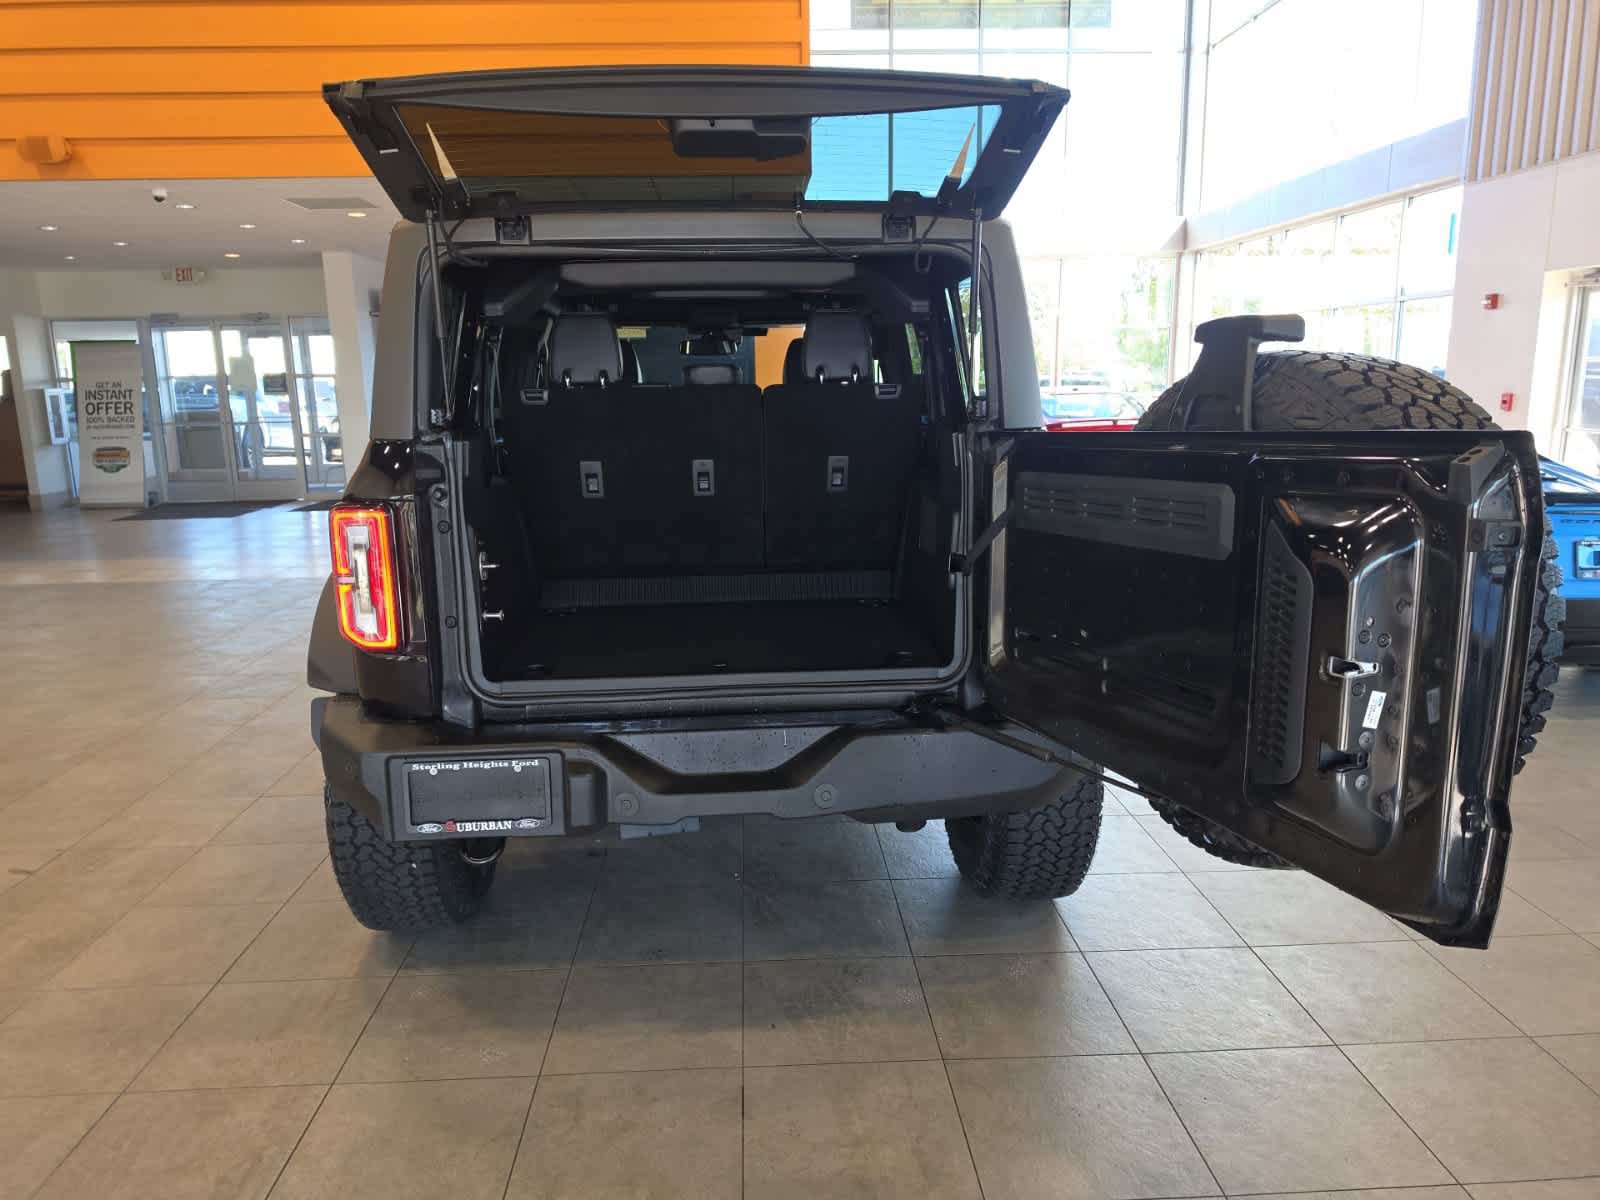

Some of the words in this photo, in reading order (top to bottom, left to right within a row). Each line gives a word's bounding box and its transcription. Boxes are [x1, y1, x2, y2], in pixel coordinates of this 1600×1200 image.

[176, 267, 192, 281] EXIT
[85, 390, 133, 400] INSTANT
[85, 402, 133, 415] OFFER
[107, 416, 135, 424] BACKED
[463, 761, 508, 769] Heights
[446, 821, 512, 832] SUBURBAN
